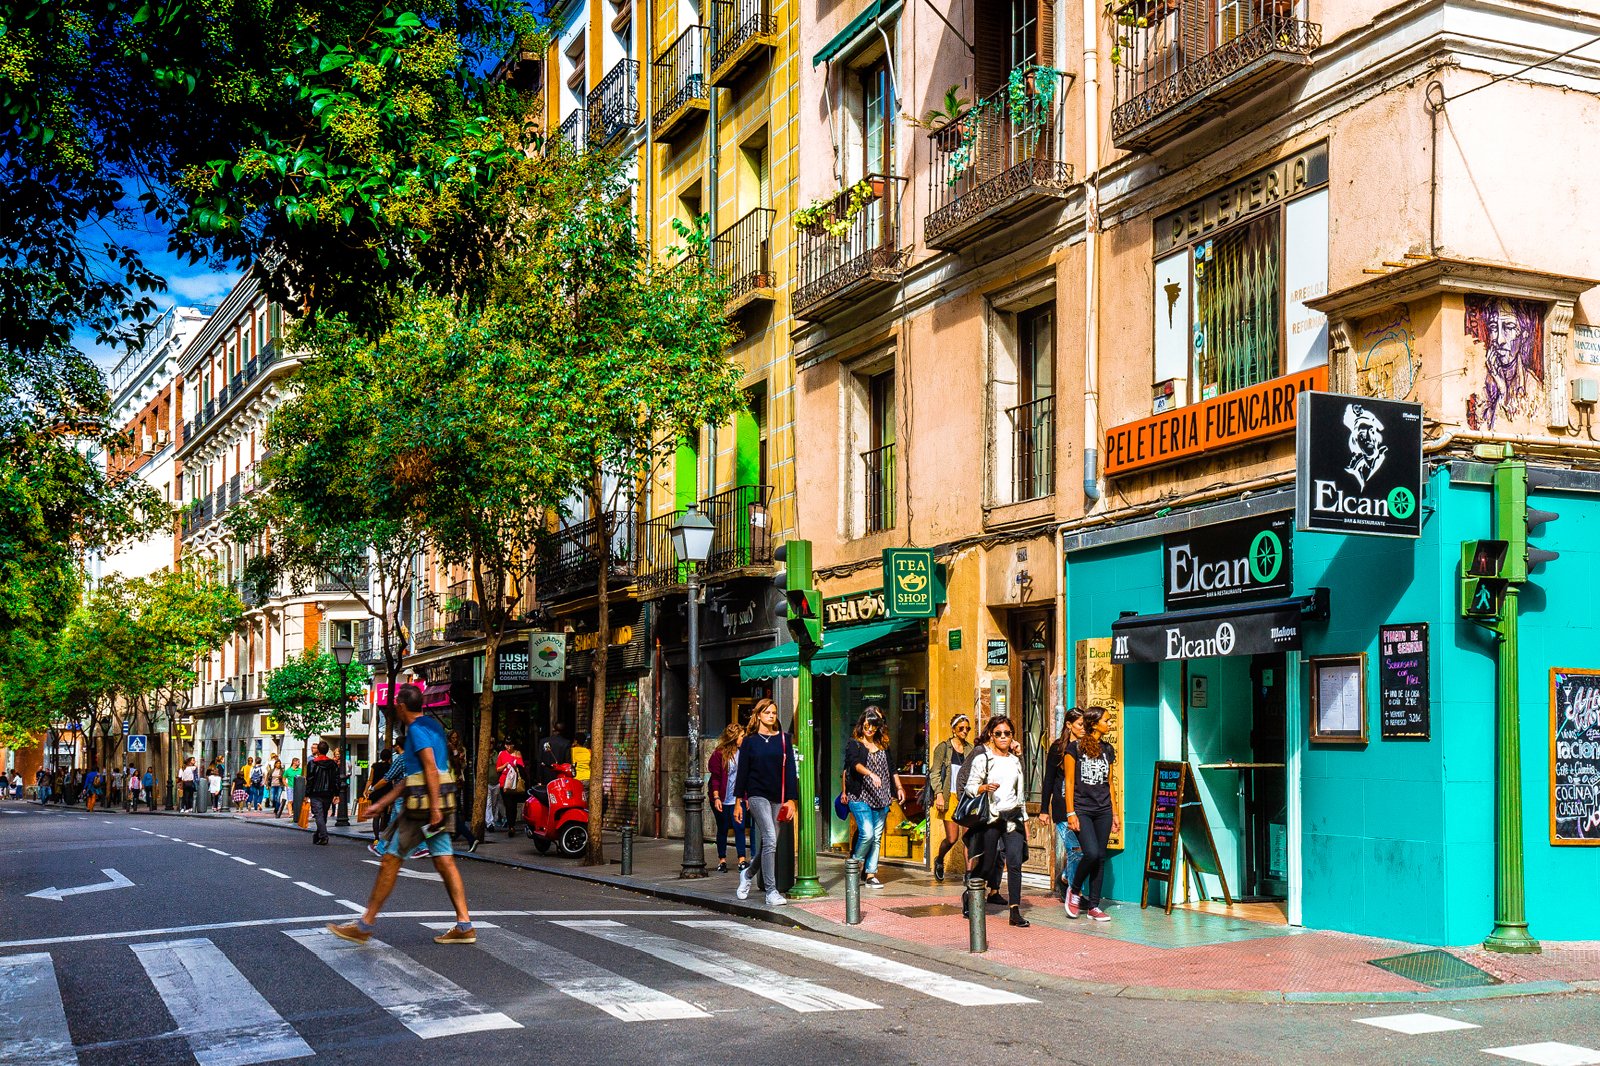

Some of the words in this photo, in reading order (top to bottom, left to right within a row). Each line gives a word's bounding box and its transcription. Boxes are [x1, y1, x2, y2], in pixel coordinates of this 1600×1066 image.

[1173, 157, 1308, 246] PELETERIA
[1106, 411, 1199, 468] PELETERIA
[1206, 377, 1314, 442] FUENCARR
[896, 560, 926, 571] TEA
[897, 593, 928, 603] SHOP
[826, 600, 859, 624] TEA
[1270, 626, 1297, 639] Mahou
[1383, 630, 1407, 643] PINCHO
[1410, 630, 1419, 641] DE
[534, 636, 563, 648] HELADOS
[1384, 644, 1393, 656] LA
[1397, 641, 1424, 655] SEMANA
[499, 653, 529, 662] LUSH
[499, 662, 529, 670] FRESH
[532, 665, 564, 678] ITALIANOS
[1556, 785, 1593, 801] COCINA
[1559, 801, 1585, 816] CASERA
